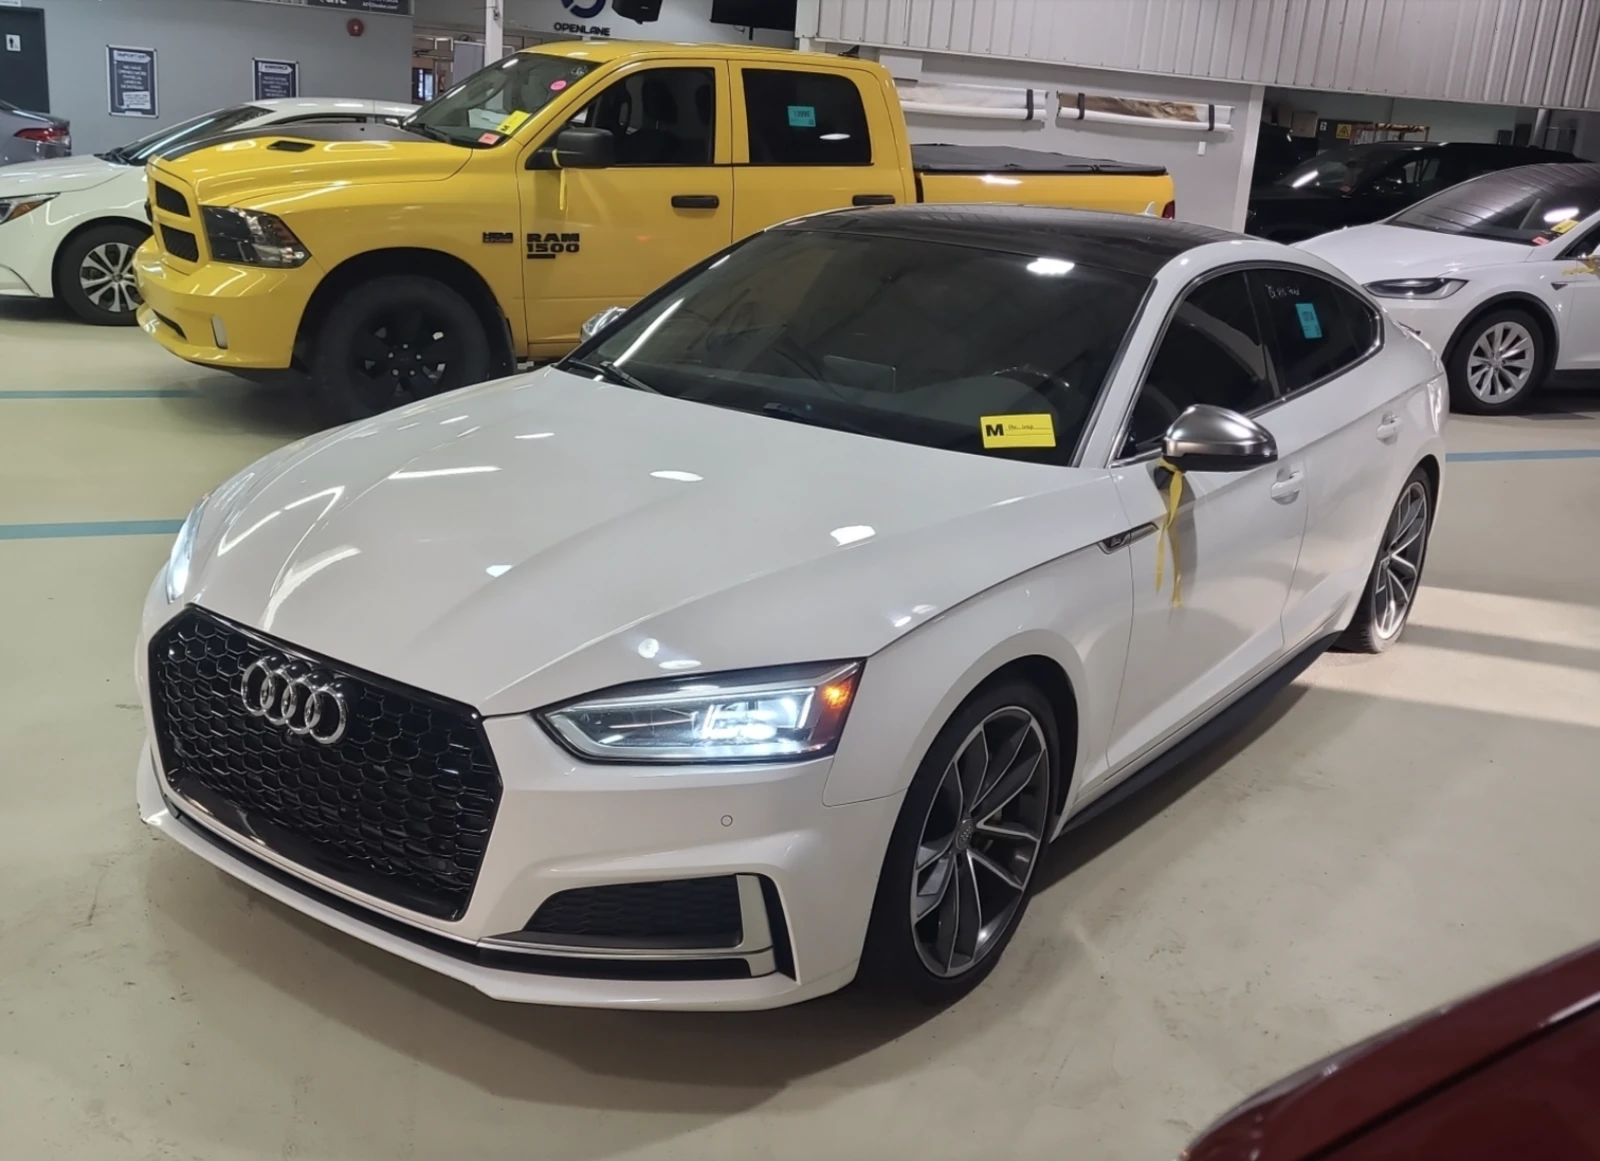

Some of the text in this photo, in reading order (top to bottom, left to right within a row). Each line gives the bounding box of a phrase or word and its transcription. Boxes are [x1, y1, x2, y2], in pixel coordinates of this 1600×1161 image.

[553, 22, 611, 36] OPENLANE
[526, 233, 580, 242] RAM
[526, 243, 580, 253] 1500
[985, 424, 1004, 436] M
